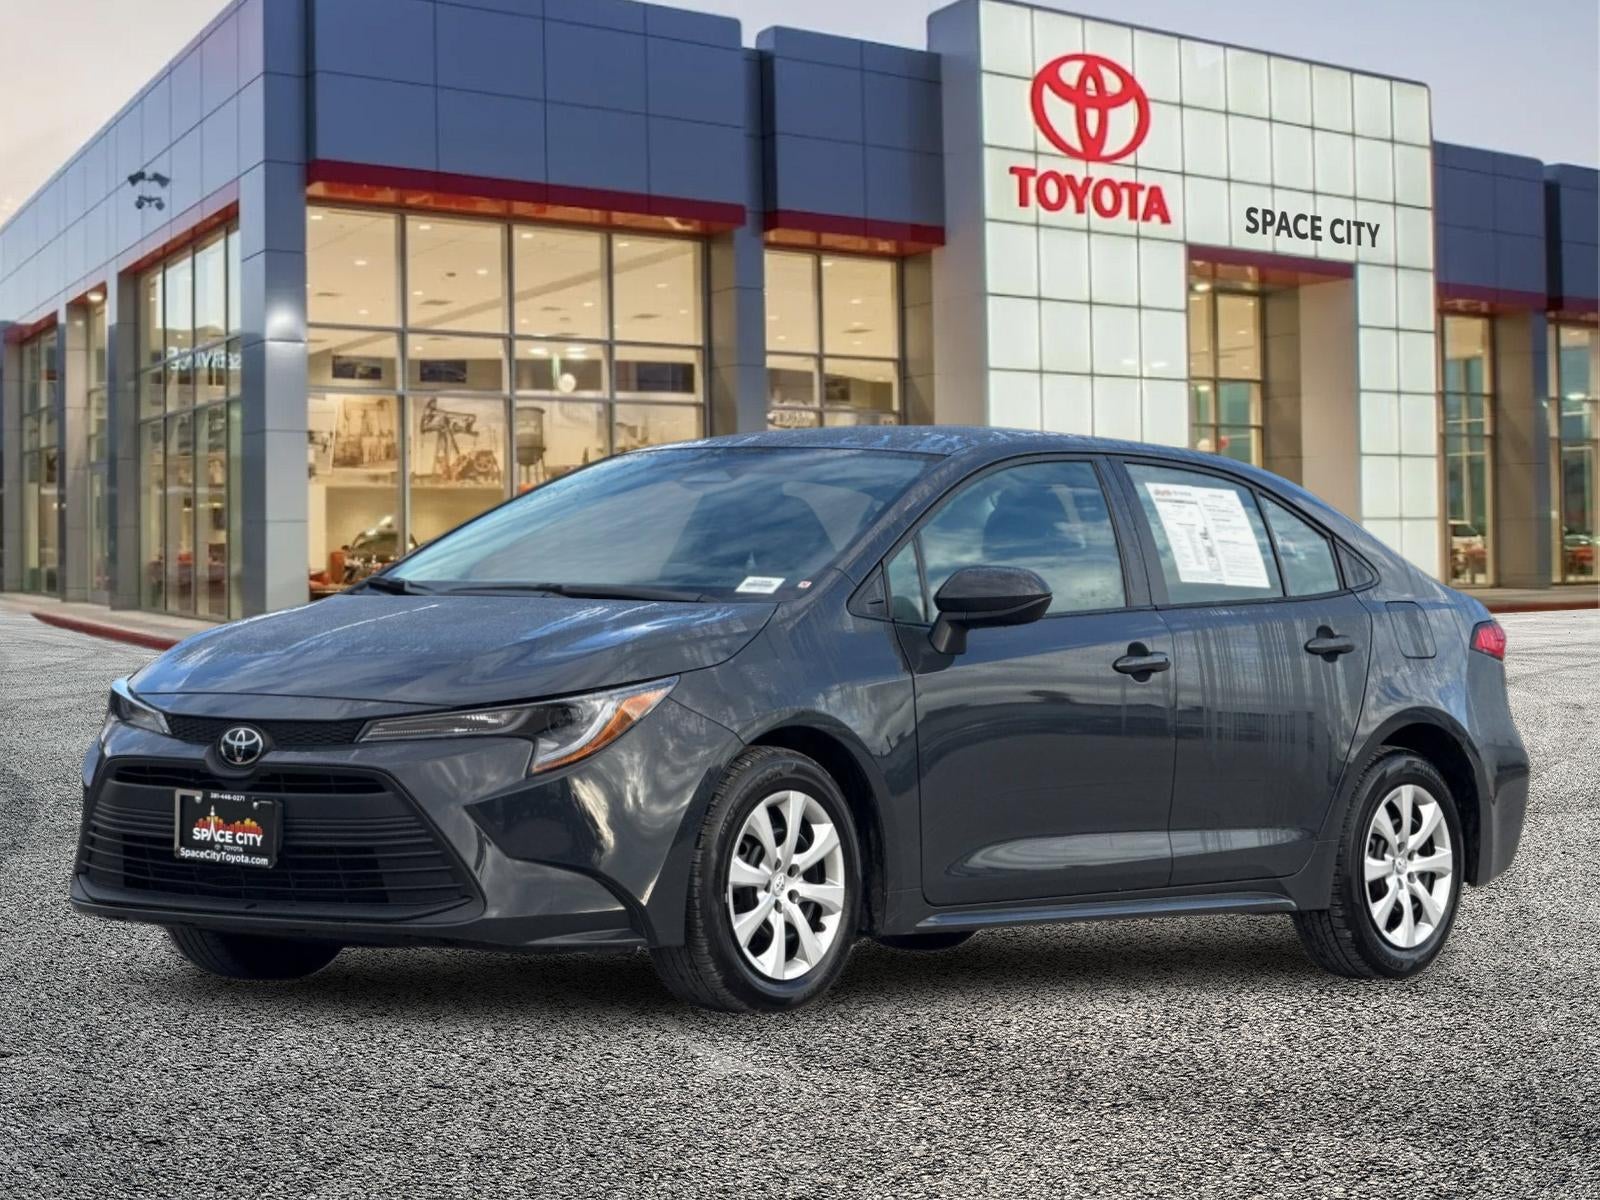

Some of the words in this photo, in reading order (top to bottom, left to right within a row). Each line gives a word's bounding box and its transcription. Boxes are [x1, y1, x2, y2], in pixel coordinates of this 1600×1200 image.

[1009, 166, 1171, 224] TOYOTA
[1245, 206, 1322, 242] SPACE
[1329, 218, 1380, 248] CITY
[192, 827, 233, 843] SPACE
[235, 832, 263, 847] CITY
[180, 847, 269, 866] SpaceCityToyota.com
[223, 845, 243, 853] TOYOTA
